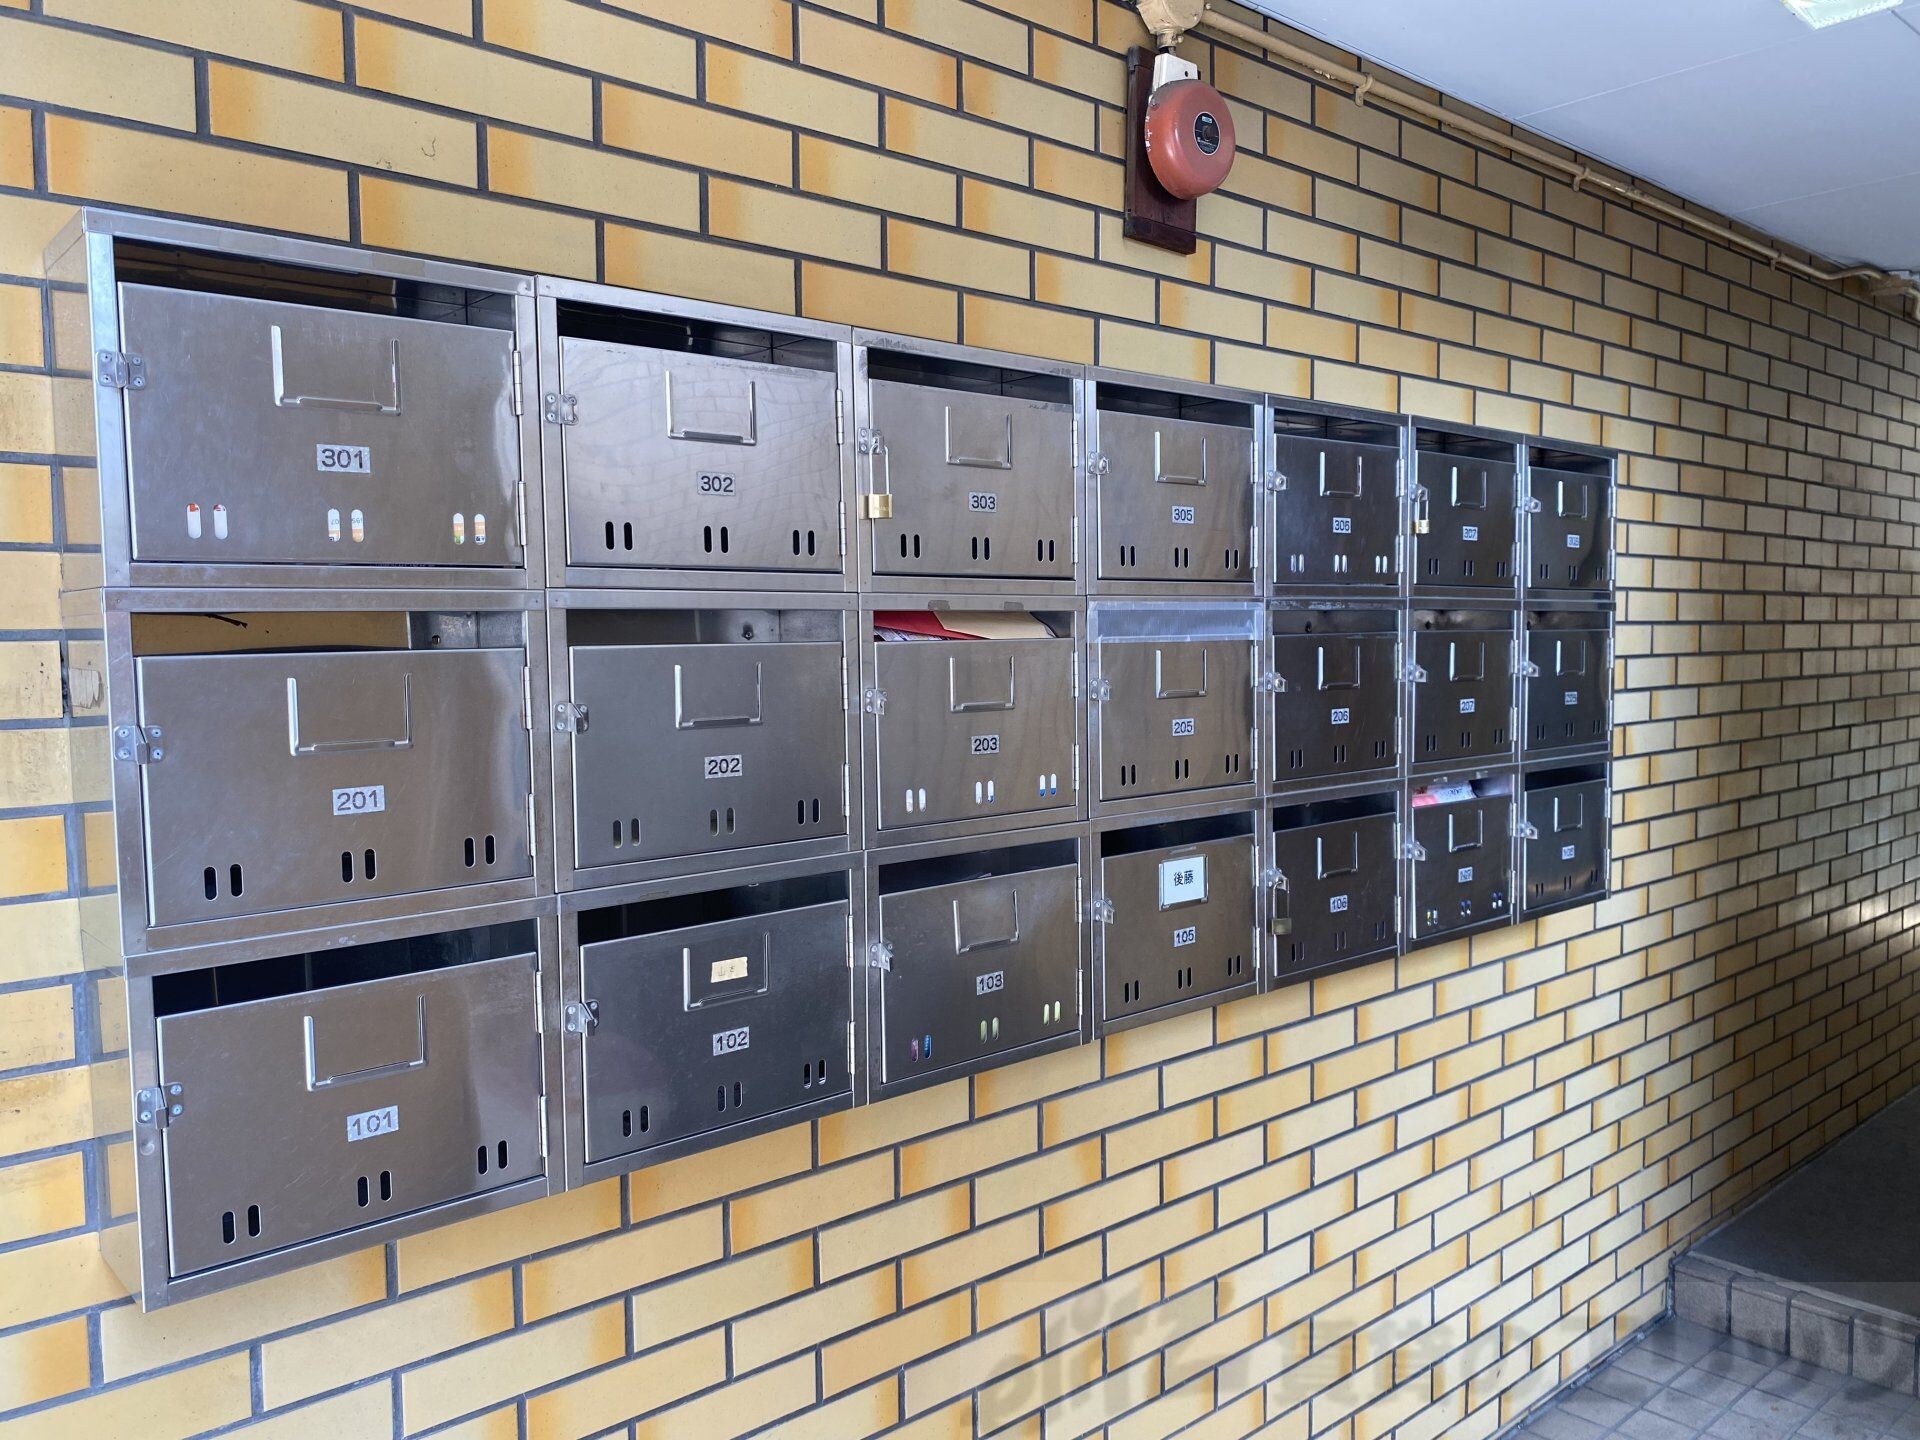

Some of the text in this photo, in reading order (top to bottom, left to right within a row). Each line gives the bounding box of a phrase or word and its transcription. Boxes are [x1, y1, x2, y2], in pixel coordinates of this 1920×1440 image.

[321, 448, 362, 468] 301
[701, 476, 733, 493] 302
[972, 496, 995, 509] 303
[1174, 509, 1192, 521] 305
[1335, 520, 1349, 531] 306
[1464, 528, 1476, 539] 307
[1462, 701, 1473, 712] 207
[1333, 711, 1348, 722] 206
[1174, 721, 1192, 734] 205
[974, 738, 997, 752] 203
[708, 758, 740, 775] 202
[337, 791, 378, 811] 201
[1173, 870, 1194, 887] 後藤
[1331, 898, 1346, 909] 106
[1176, 930, 1194, 944] 105
[979, 975, 1002, 991] 103
[716, 1031, 747, 1051] 102
[351, 1111, 393, 1137] 101
